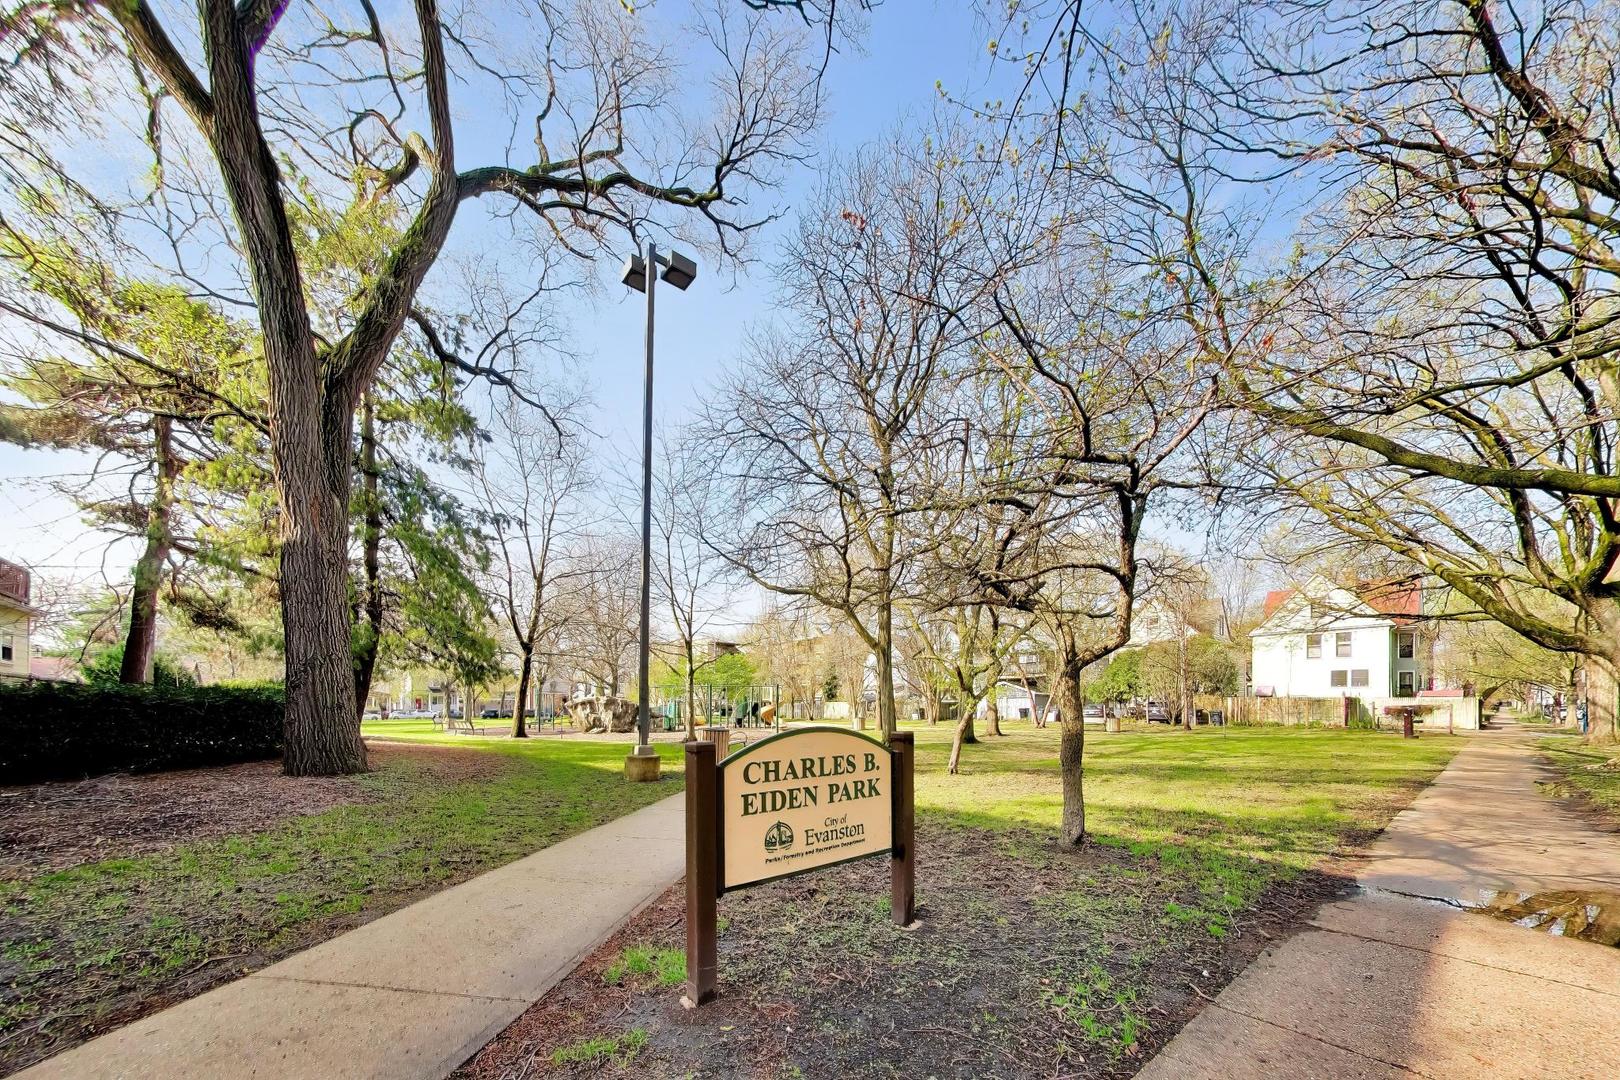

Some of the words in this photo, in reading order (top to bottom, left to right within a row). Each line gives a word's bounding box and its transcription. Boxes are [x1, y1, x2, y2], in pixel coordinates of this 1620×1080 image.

[743, 754, 856, 784] CHARLES
[864, 753, 880, 772] B.
[741, 786, 818, 816] EIDEN
[828, 778, 881, 804] PARK
[824, 816, 839, 828] City
[840, 814, 847, 824] of
[805, 823, 864, 846] Evanston
[815, 844, 840, 853] Recreation
[840, 838, 865, 848] Department
